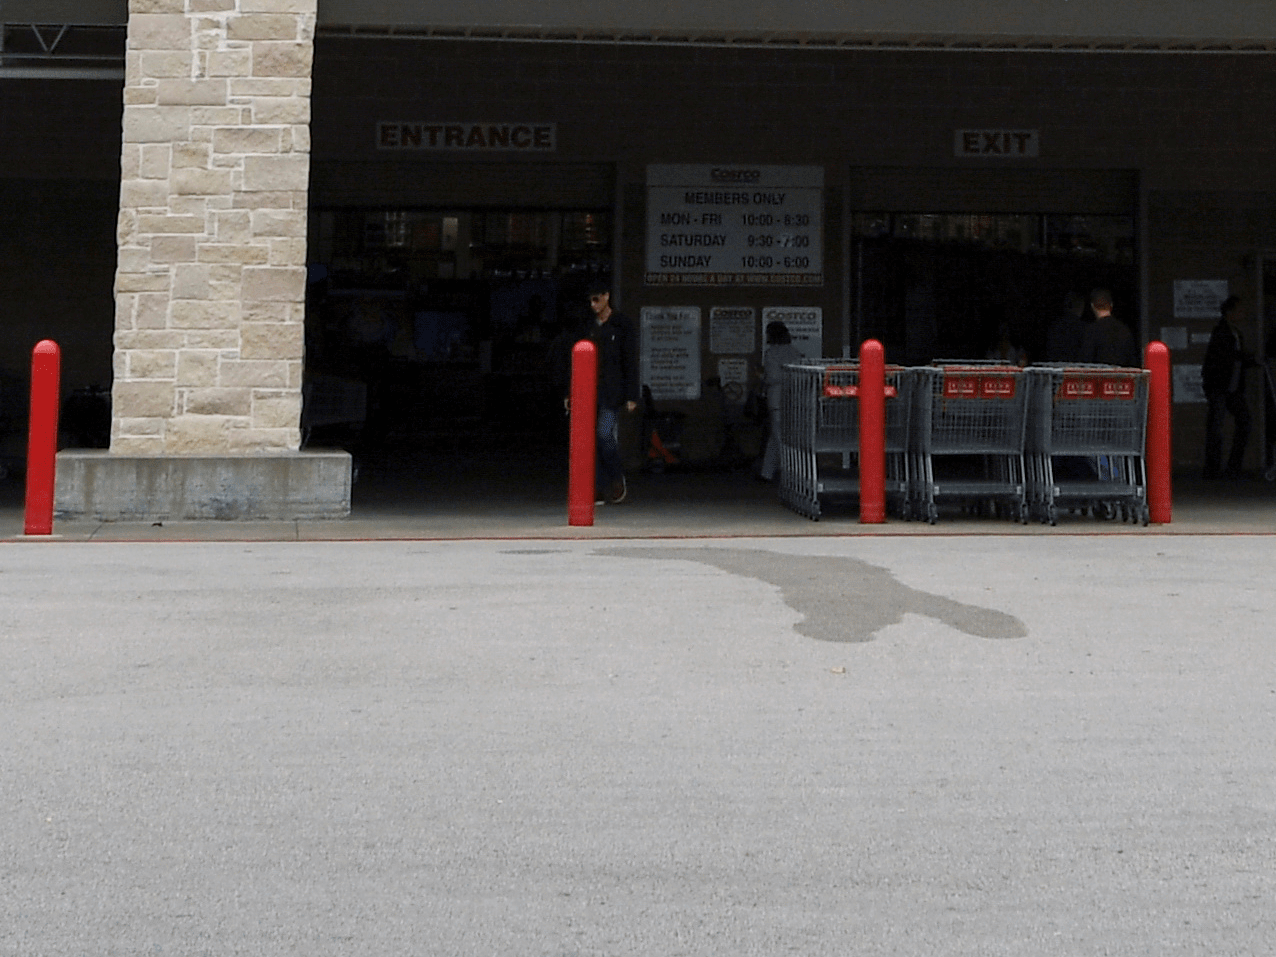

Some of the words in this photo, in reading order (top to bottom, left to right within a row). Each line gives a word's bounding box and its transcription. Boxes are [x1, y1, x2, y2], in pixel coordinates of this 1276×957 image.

[380, 124, 552, 148] ENTRANCE
[963, 132, 1031, 154] EXIT
[684, 192, 750, 205] MEMBERS
[753, 192, 786, 205] ONLY
[660, 213, 690, 225] MON
[702, 213, 722, 225] FRI
[742, 214, 773, 226] 10:00
[660, 234, 727, 247] SATURDAY
[747, 235, 773, 247] 9:30
[660, 255, 712, 268] SUNDAY
[742, 256, 773, 268] 10:00
[784, 256, 809, 268] 6:00
